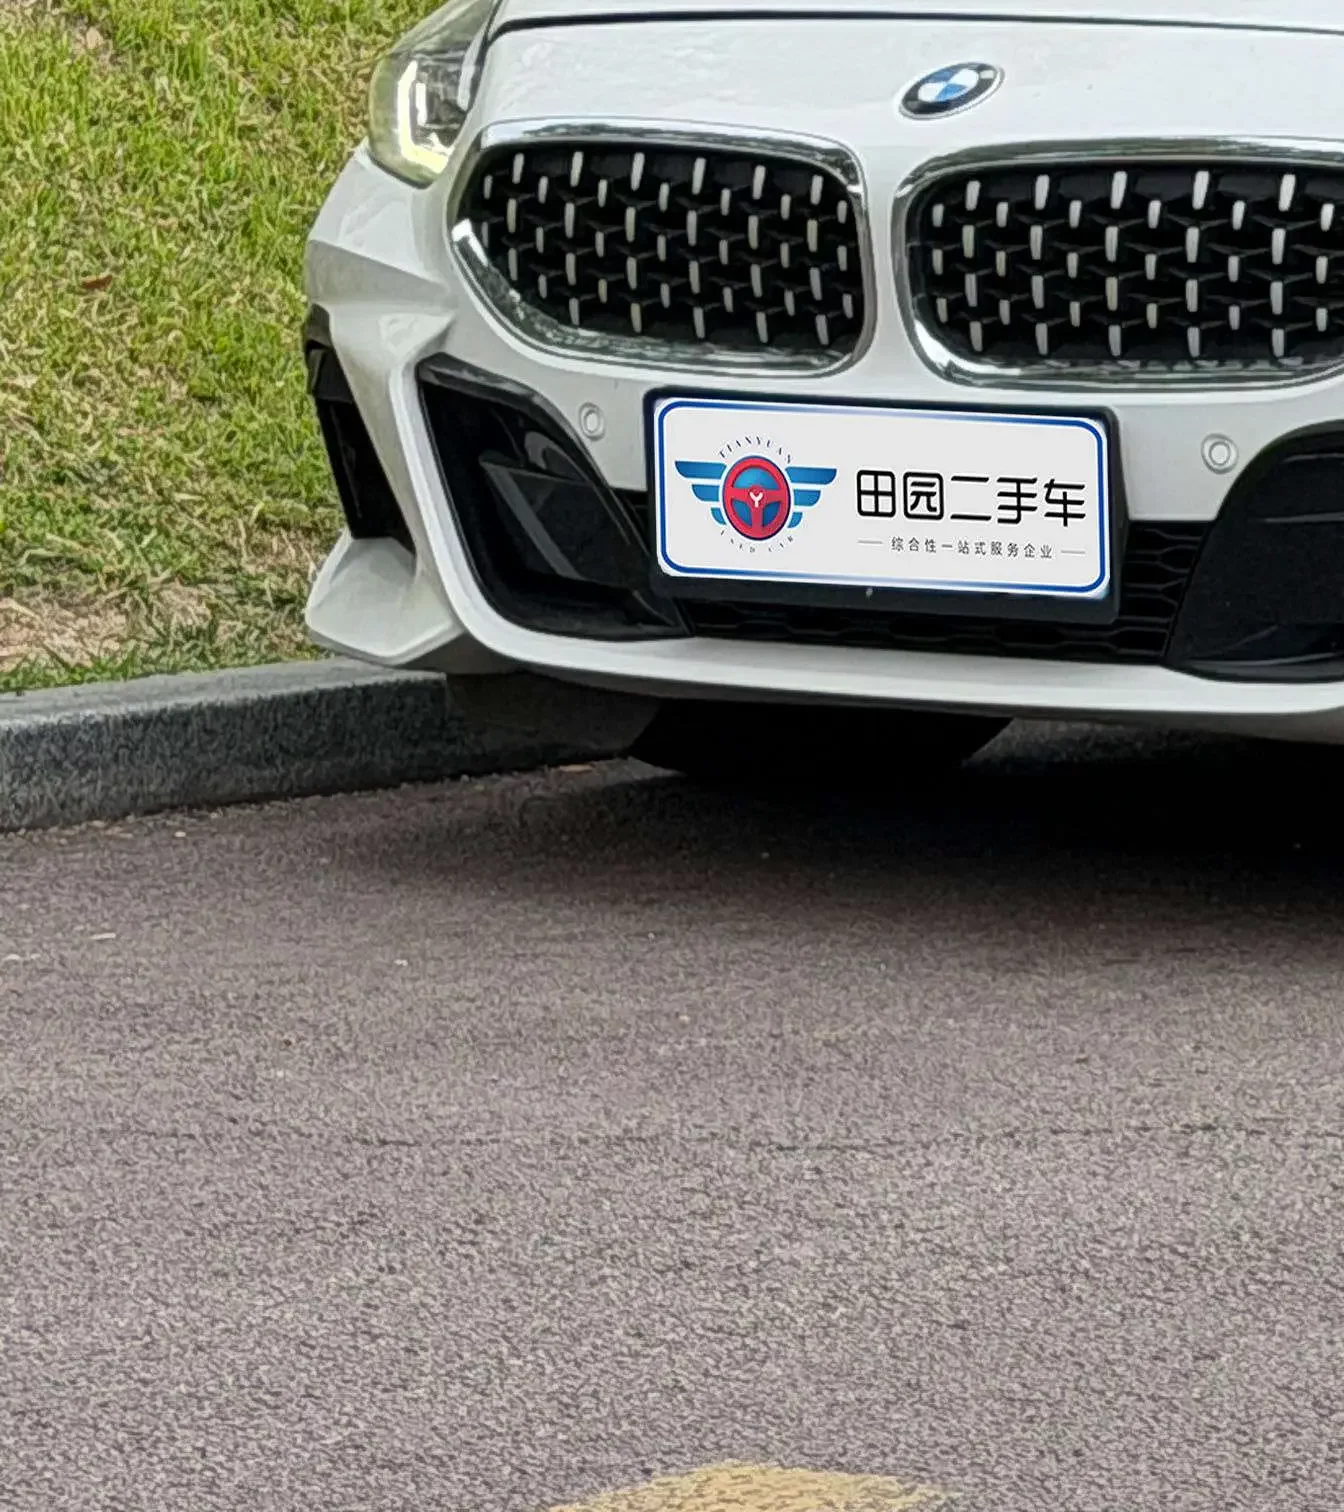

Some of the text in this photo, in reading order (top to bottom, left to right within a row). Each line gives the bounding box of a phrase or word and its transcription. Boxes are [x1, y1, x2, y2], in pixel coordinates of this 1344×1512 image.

[749, 491, 764, 508] Y
[856, 469, 1086, 527] 田园二手车
[890, 536, 1053, 560] 综合性一站式服务企业
